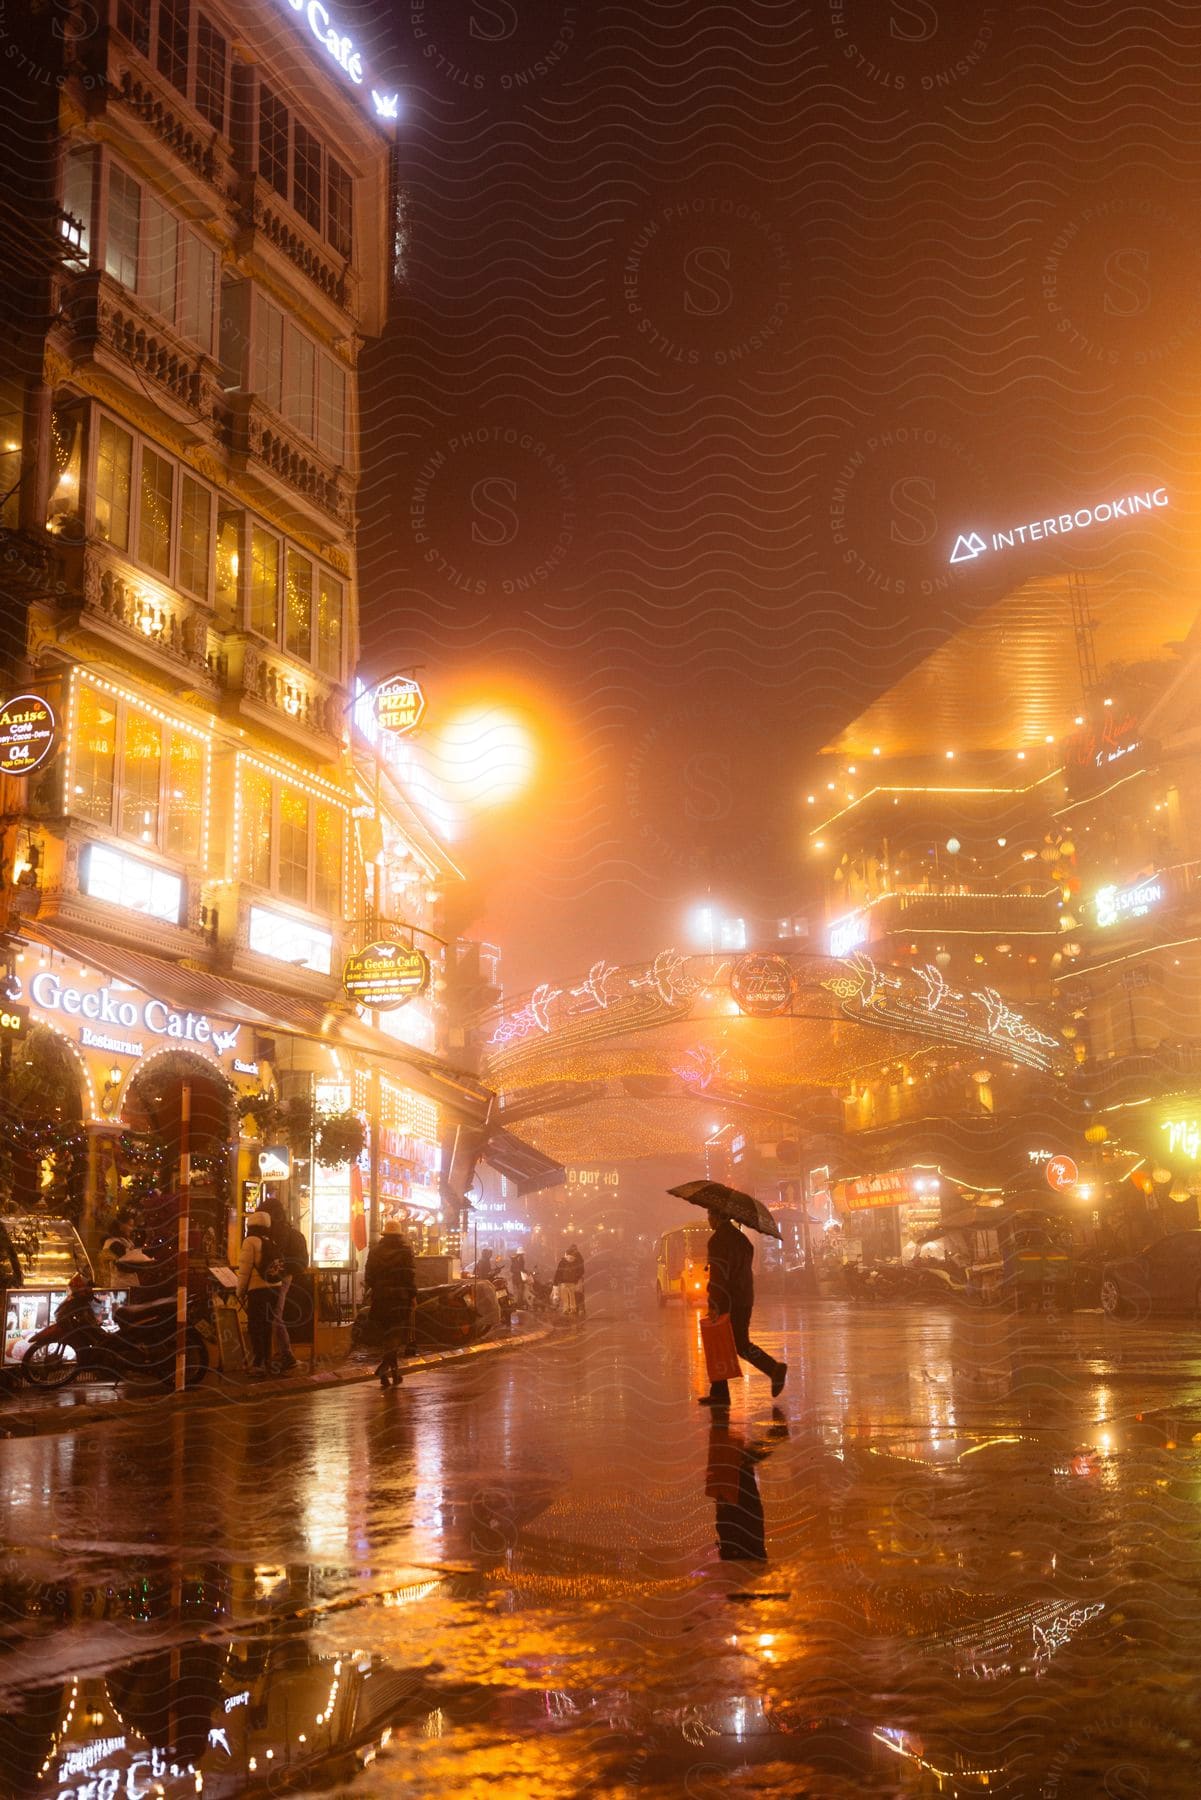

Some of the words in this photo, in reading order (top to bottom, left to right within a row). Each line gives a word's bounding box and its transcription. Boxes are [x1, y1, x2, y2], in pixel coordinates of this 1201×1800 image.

[307, 0, 363, 84] Café
[992, 487, 1169, 551] INTERBOOKING
[379, 693, 416, 711] PIZZA
[0, 710, 47, 725] Anise
[378, 709, 416, 728] STEAK
[9, 722, 33, 734] Café
[9, 745, 29, 760] 04
[1120, 885, 1161, 909] SAIGON
[349, 960, 363, 971] Le
[364, 957, 395, 970] Gecko
[397, 955, 419, 967] Café
[31, 972, 139, 1028] Gecko
[143, 1000, 211, 1042] Café
[0, 1010, 20, 1029] ea
[81, 1026, 144, 1057] Restaurant
[233, 1058, 259, 1076] Snack
